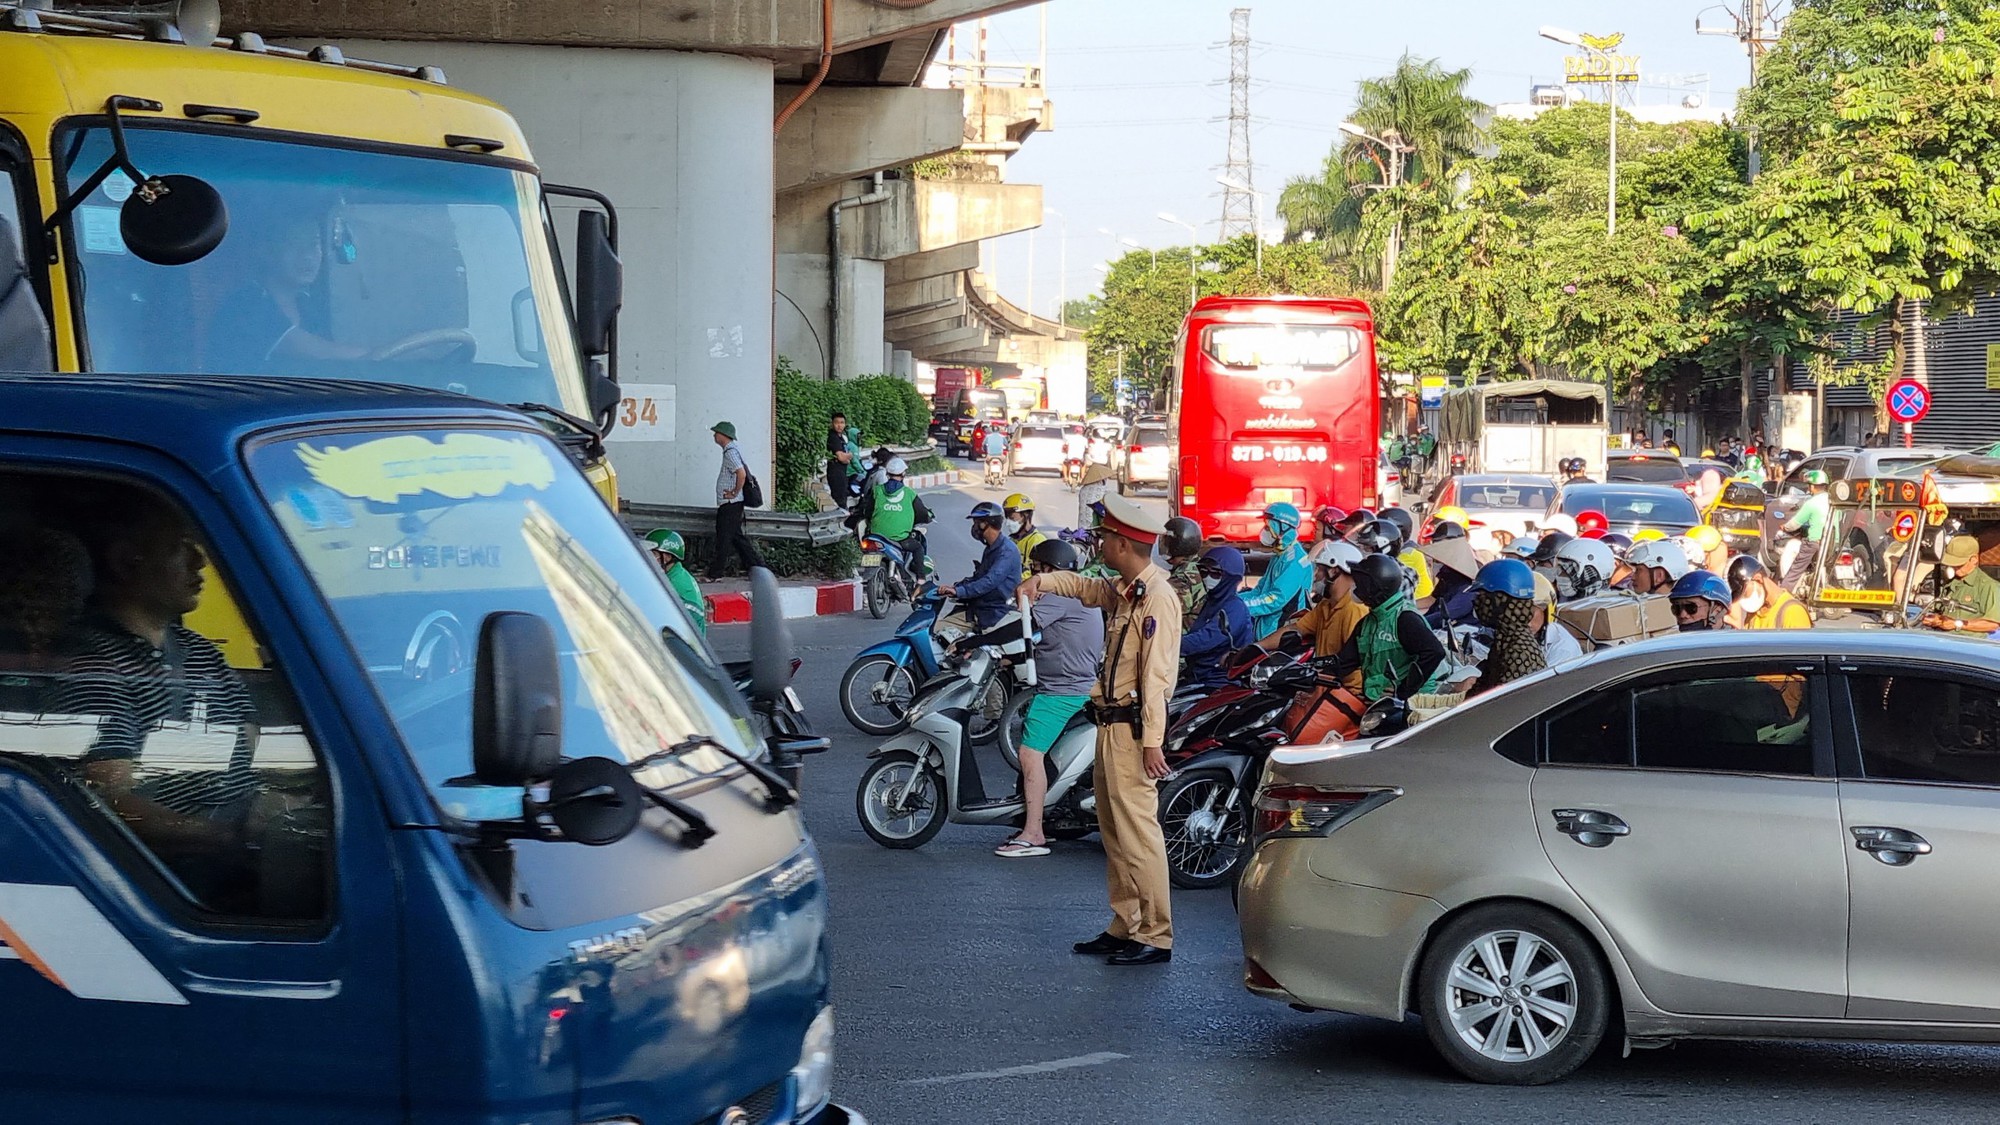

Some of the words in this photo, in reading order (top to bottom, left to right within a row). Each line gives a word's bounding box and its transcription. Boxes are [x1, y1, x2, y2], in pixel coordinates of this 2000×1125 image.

[620, 397, 658, 427] 34
[883, 503, 903, 512] Grab
[662, 538, 680, 550] Grab
